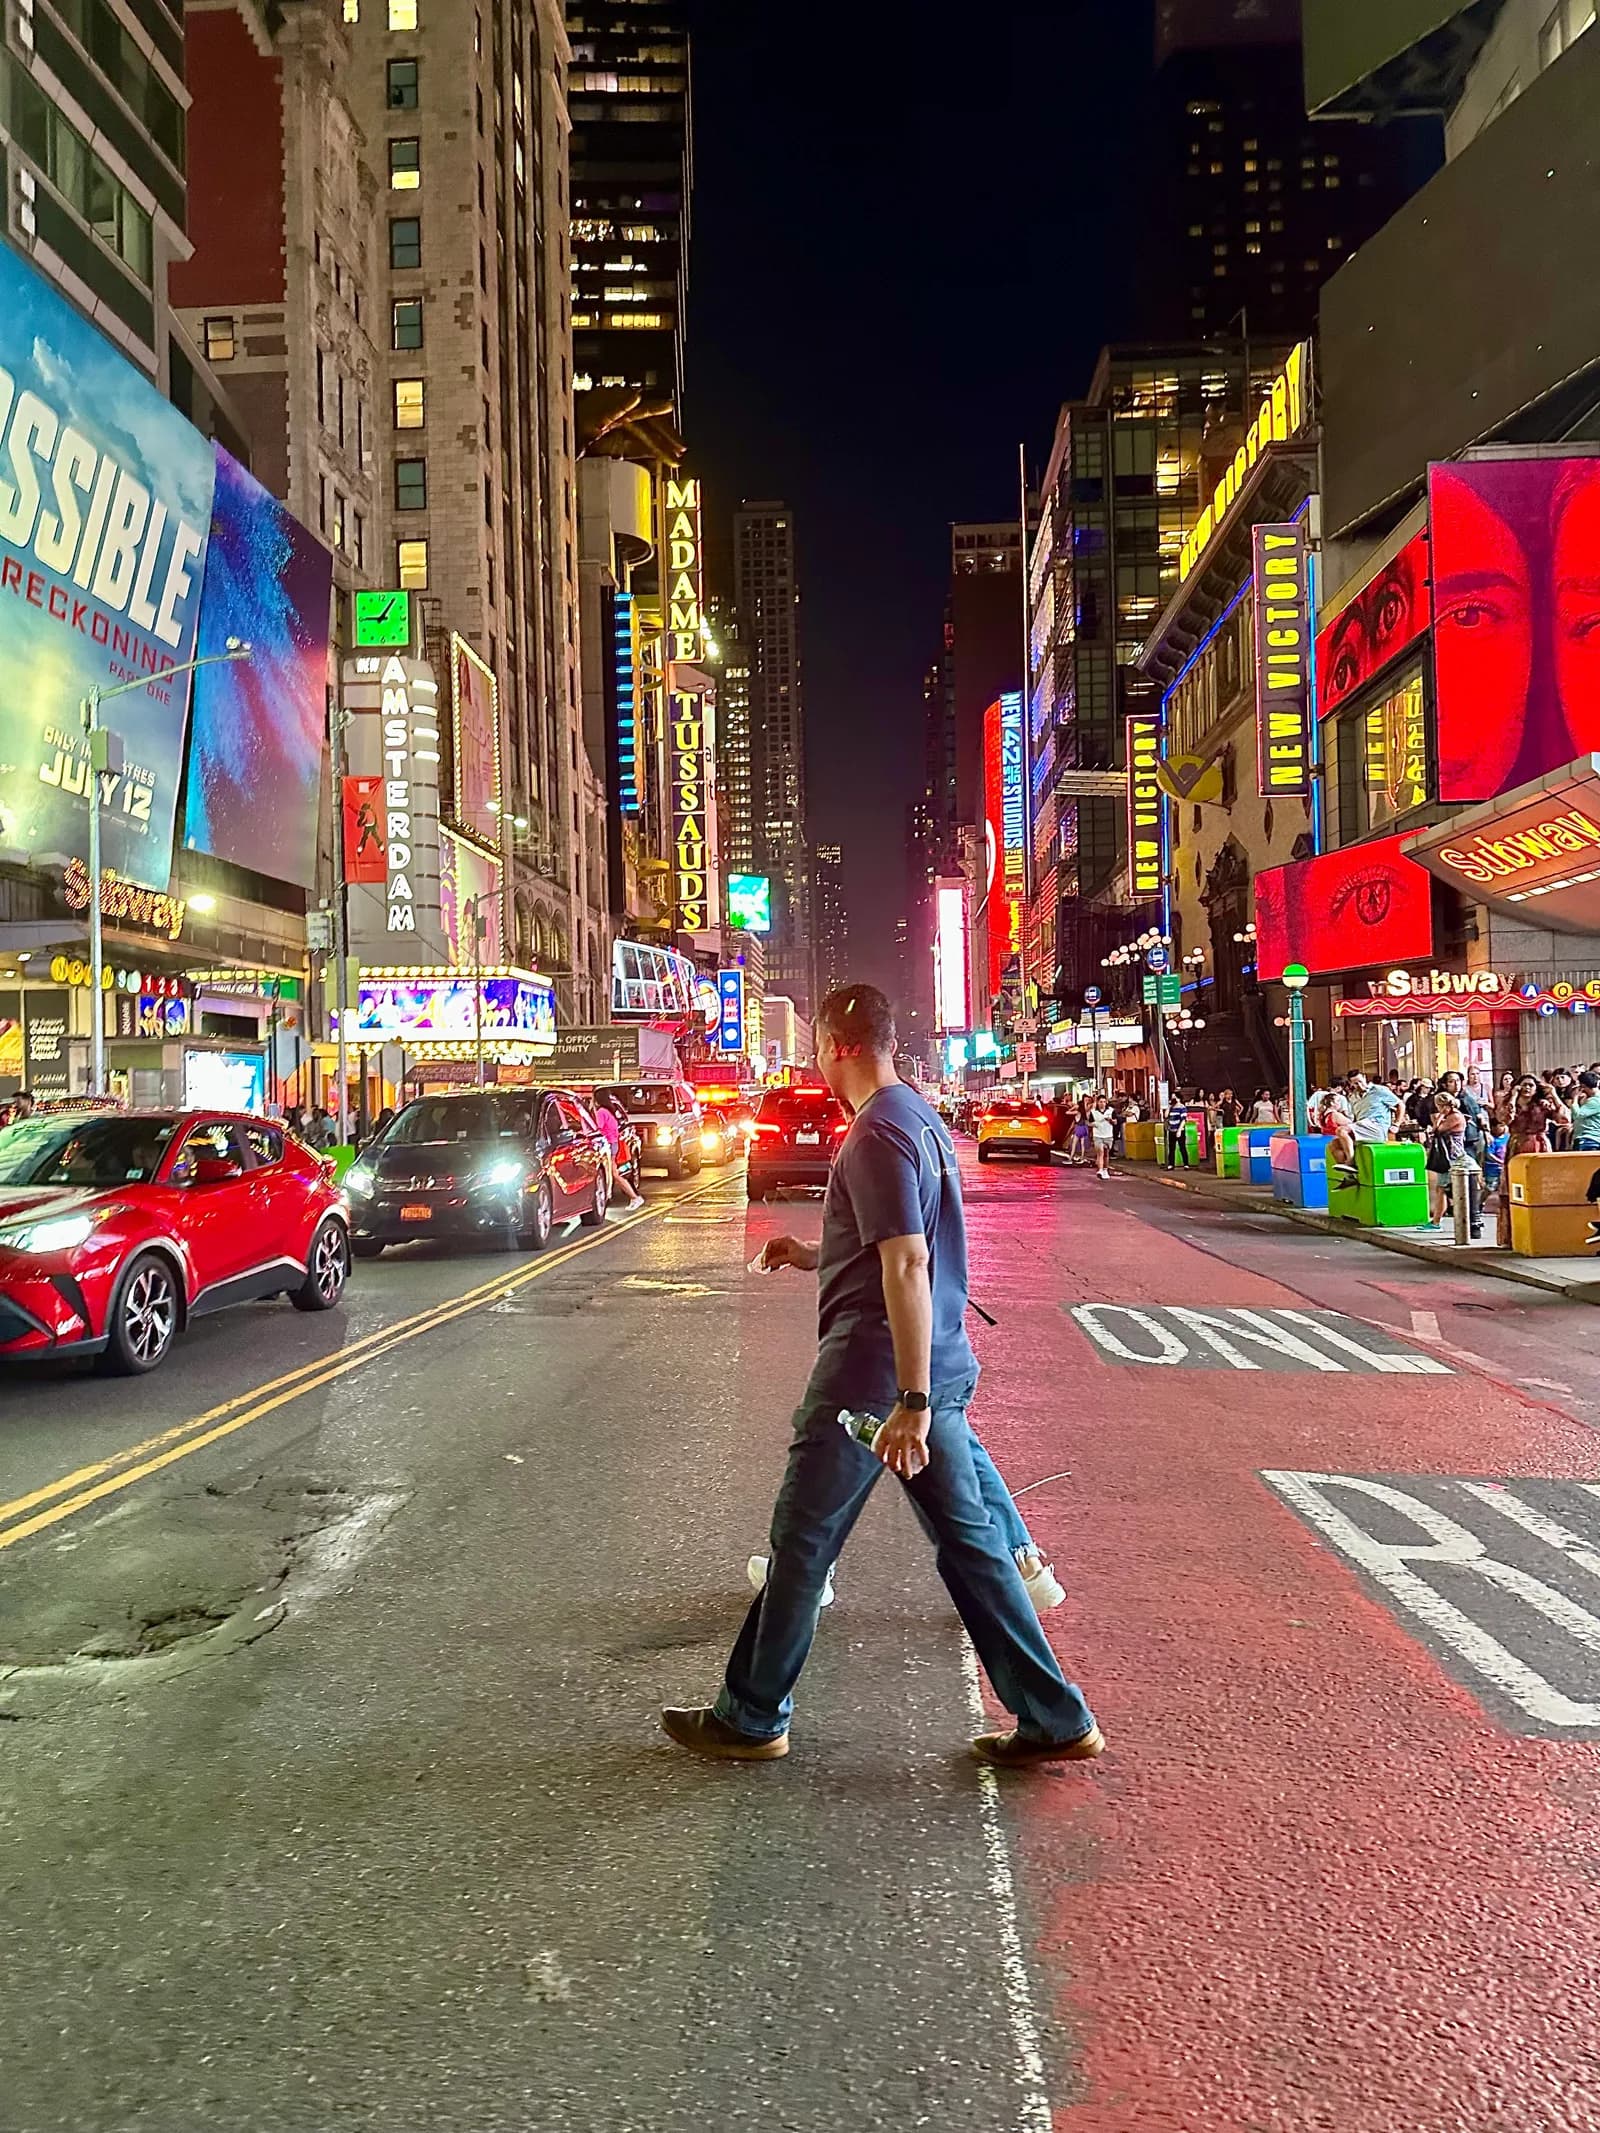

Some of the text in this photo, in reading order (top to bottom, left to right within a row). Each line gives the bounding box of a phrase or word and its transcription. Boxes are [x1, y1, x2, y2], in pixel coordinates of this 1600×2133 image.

[0, 365, 202, 648] SSIBLE
[665, 480, 699, 661] MADAME
[1, 556, 177, 685] RECKONING
[1264, 534, 1302, 785] NEW VICTORY
[147, 682, 172, 706] ONE
[1001, 692, 1022, 727] NEW
[43, 725, 78, 753] ONLY
[1002, 728, 1020, 764] 42
[122, 780, 153, 821] 12
[381, 656, 415, 932] AMSTERDAM
[1134, 722, 1159, 889] NEW VICTORY
[1003, 785, 1024, 848] STUDIOS
[1439, 811, 1600, 882] Subway
[1386, 969, 1516, 997] Subway
[1525, 984, 1538, 998] A
[1558, 985, 1569, 998] Q
[1541, 1001, 1586, 1016] C E
[554, 1045, 589, 1053] TUNITY
[1019, 1054, 1034, 1063] 25
[1071, 1303, 1457, 1375] ONL
